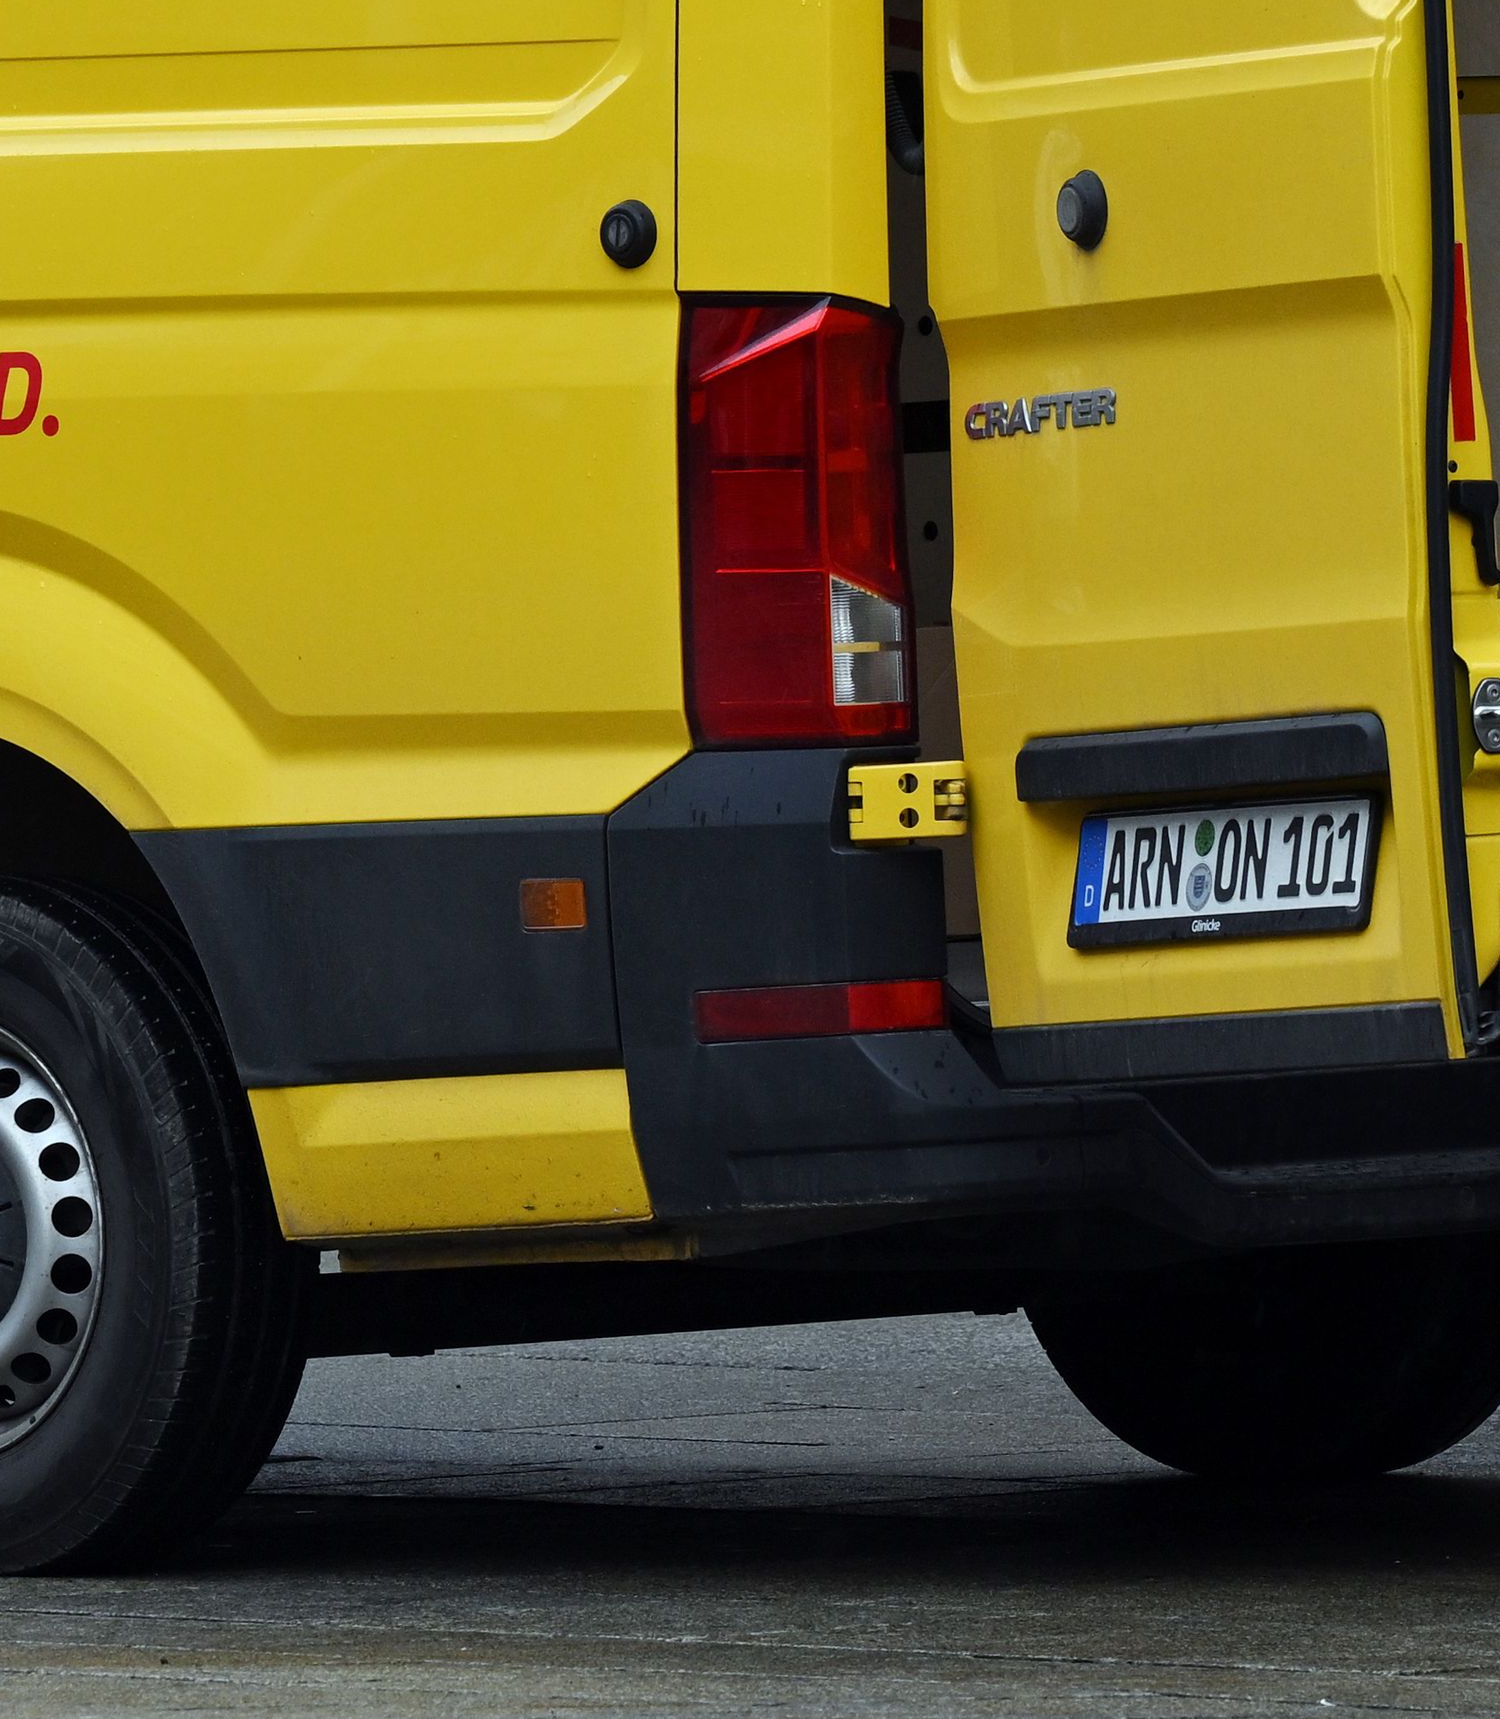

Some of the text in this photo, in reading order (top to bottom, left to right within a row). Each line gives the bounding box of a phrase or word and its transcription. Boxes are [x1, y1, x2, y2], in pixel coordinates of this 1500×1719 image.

[965, 386, 1117, 440] CRAFTER
[1083, 811, 1359, 912] D ARN ON 101
